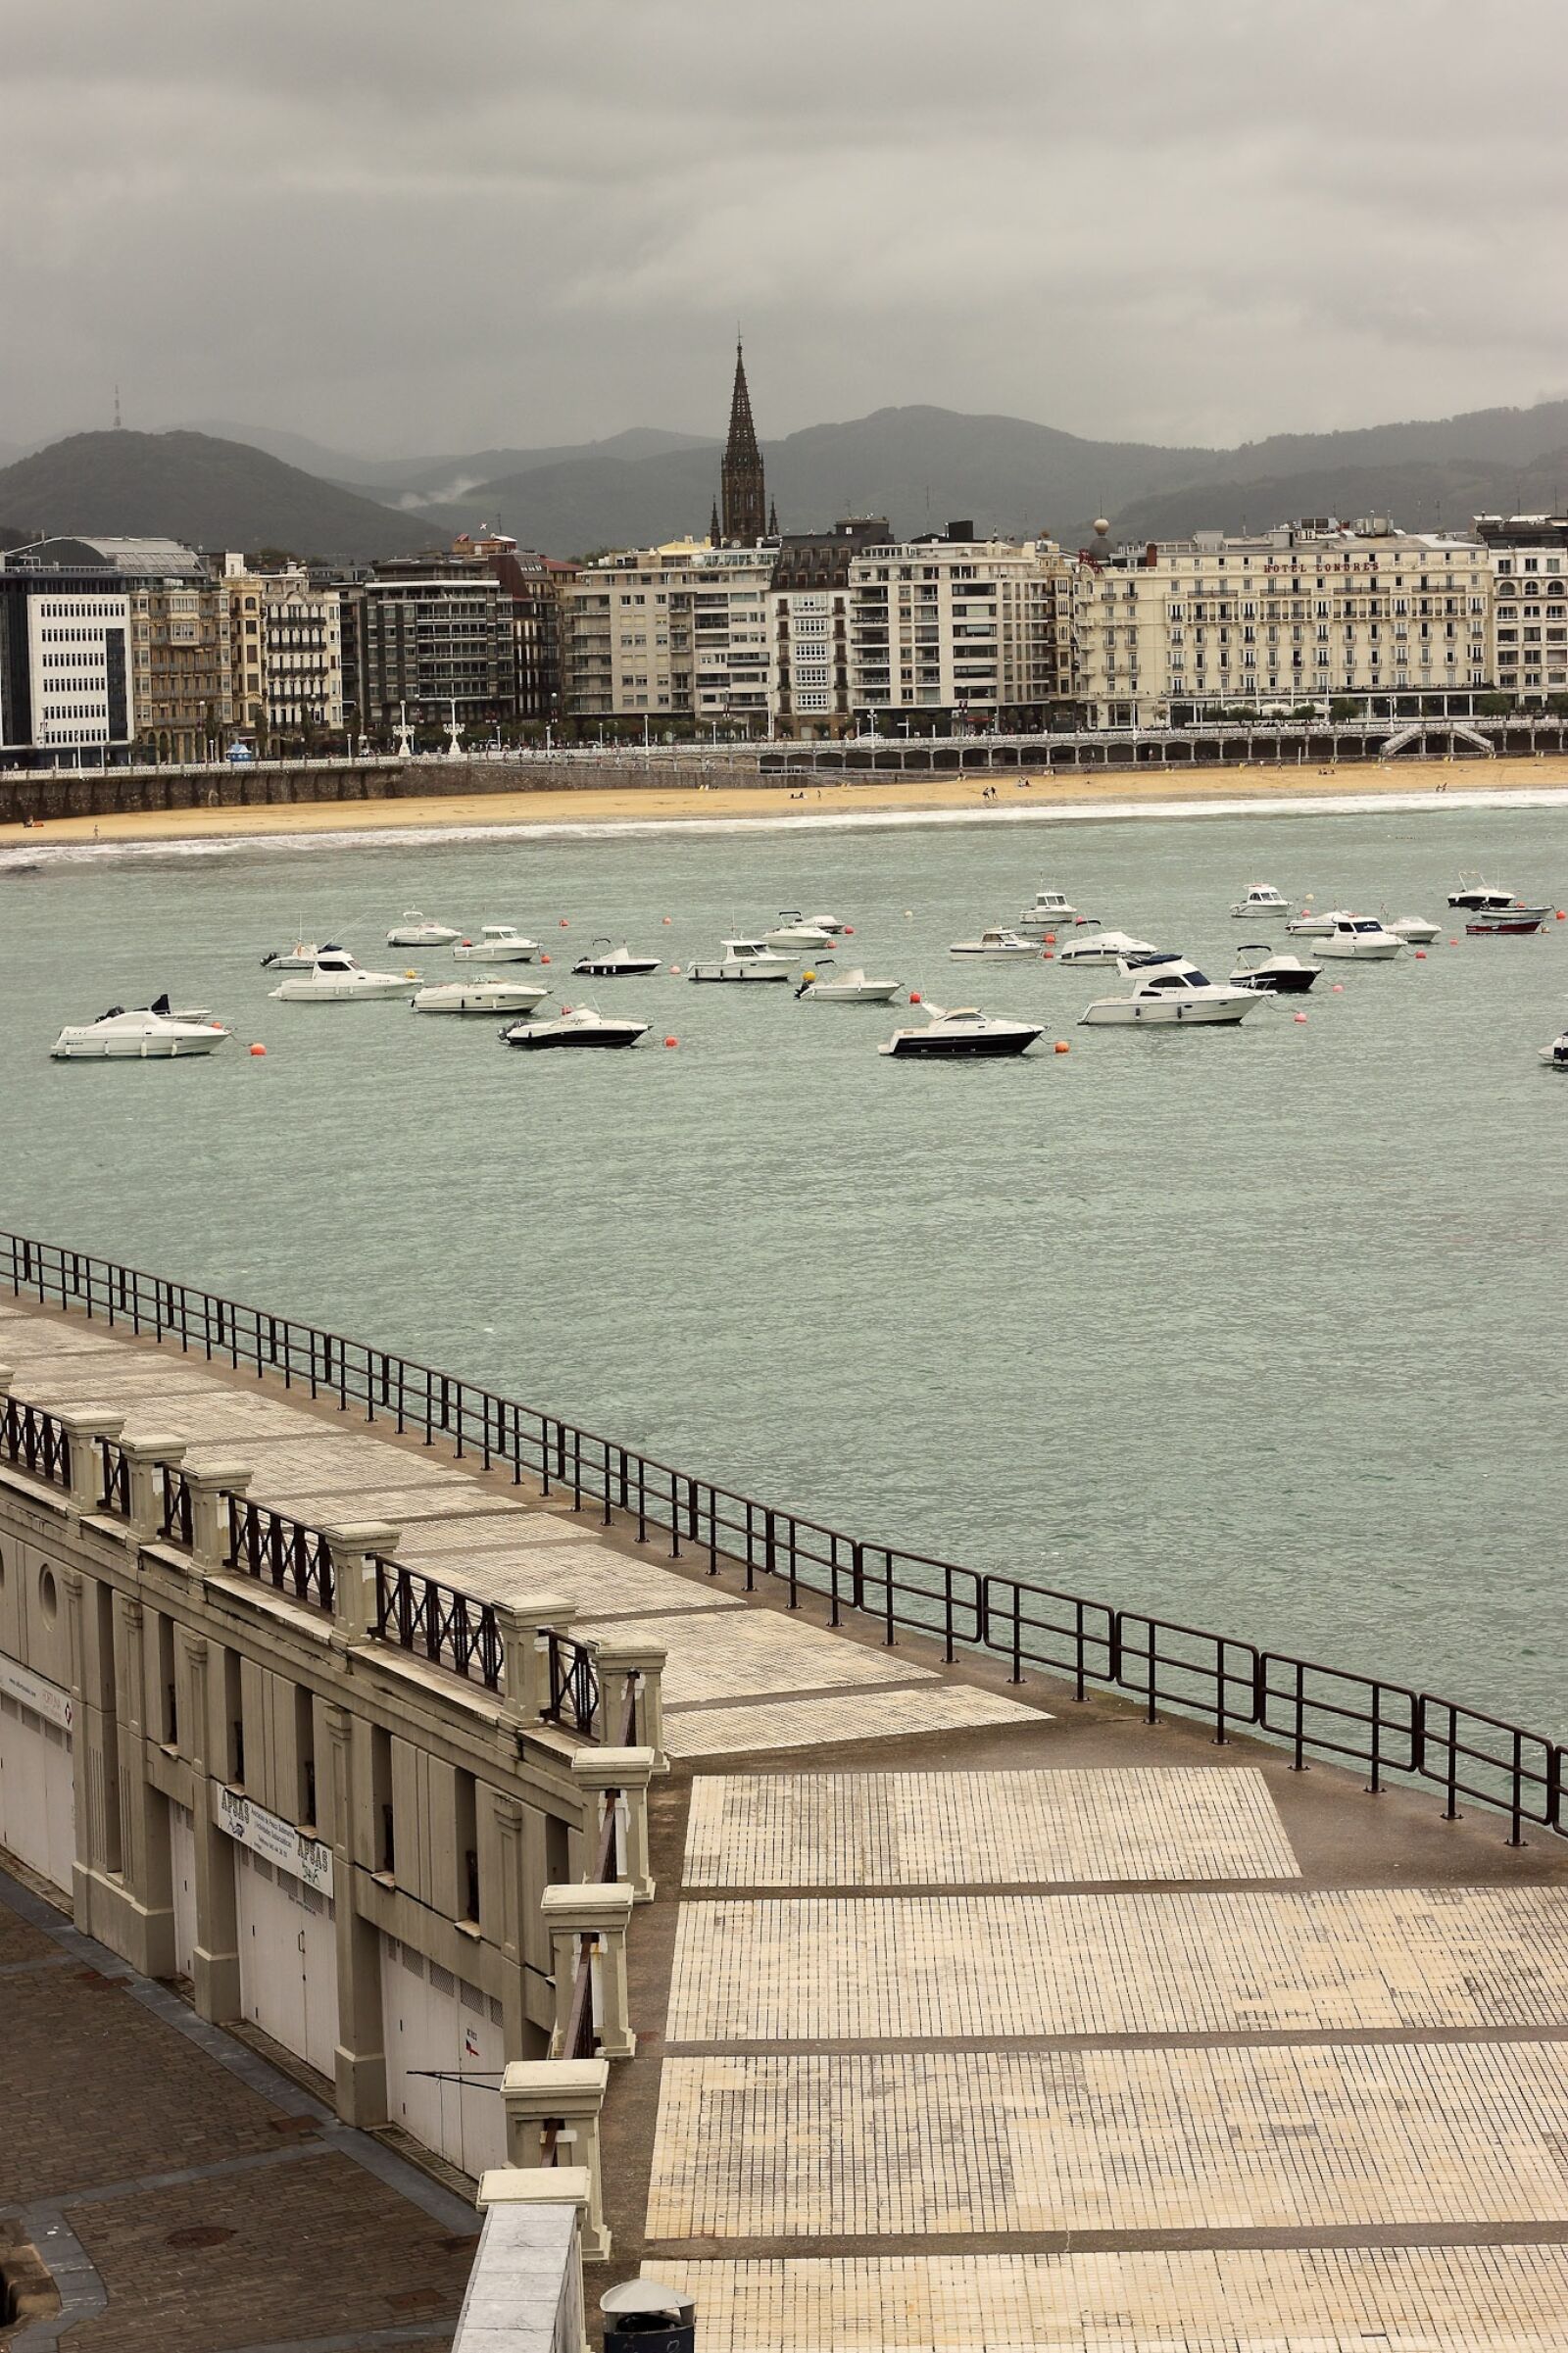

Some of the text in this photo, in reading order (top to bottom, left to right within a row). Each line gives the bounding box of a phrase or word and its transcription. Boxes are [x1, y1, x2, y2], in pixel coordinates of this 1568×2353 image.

[1263, 563, 1380, 573] HOTEL LONDRES
[298, 1834, 328, 1873] APSAS
